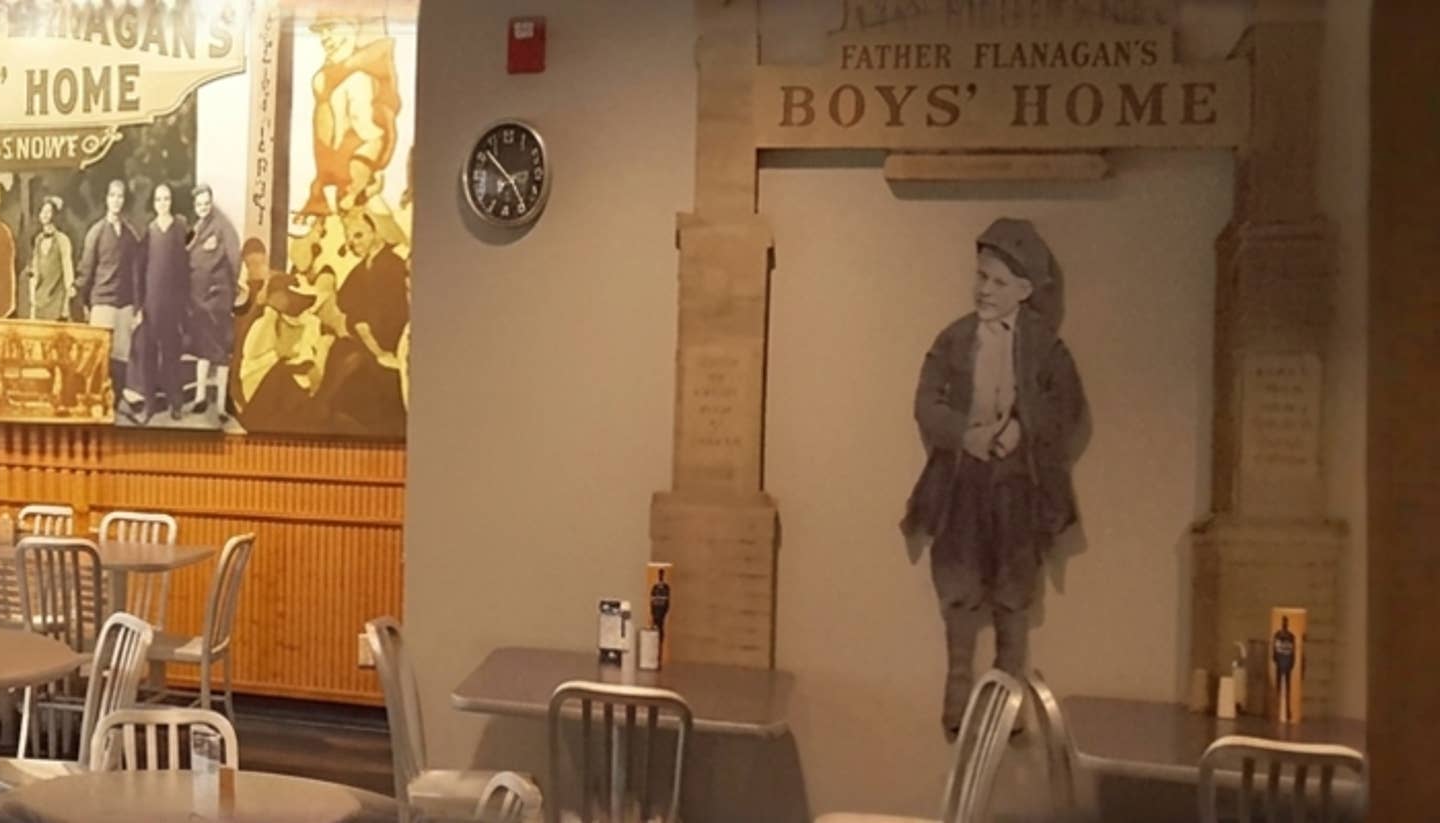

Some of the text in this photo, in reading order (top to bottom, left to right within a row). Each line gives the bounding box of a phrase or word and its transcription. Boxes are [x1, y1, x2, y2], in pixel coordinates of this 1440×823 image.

[840, 39, 1159, 71] FATHER FLANAGAN'S
[25, 63, 141, 117] HOME
[778, 81, 1219, 128] BOYS' HOME
